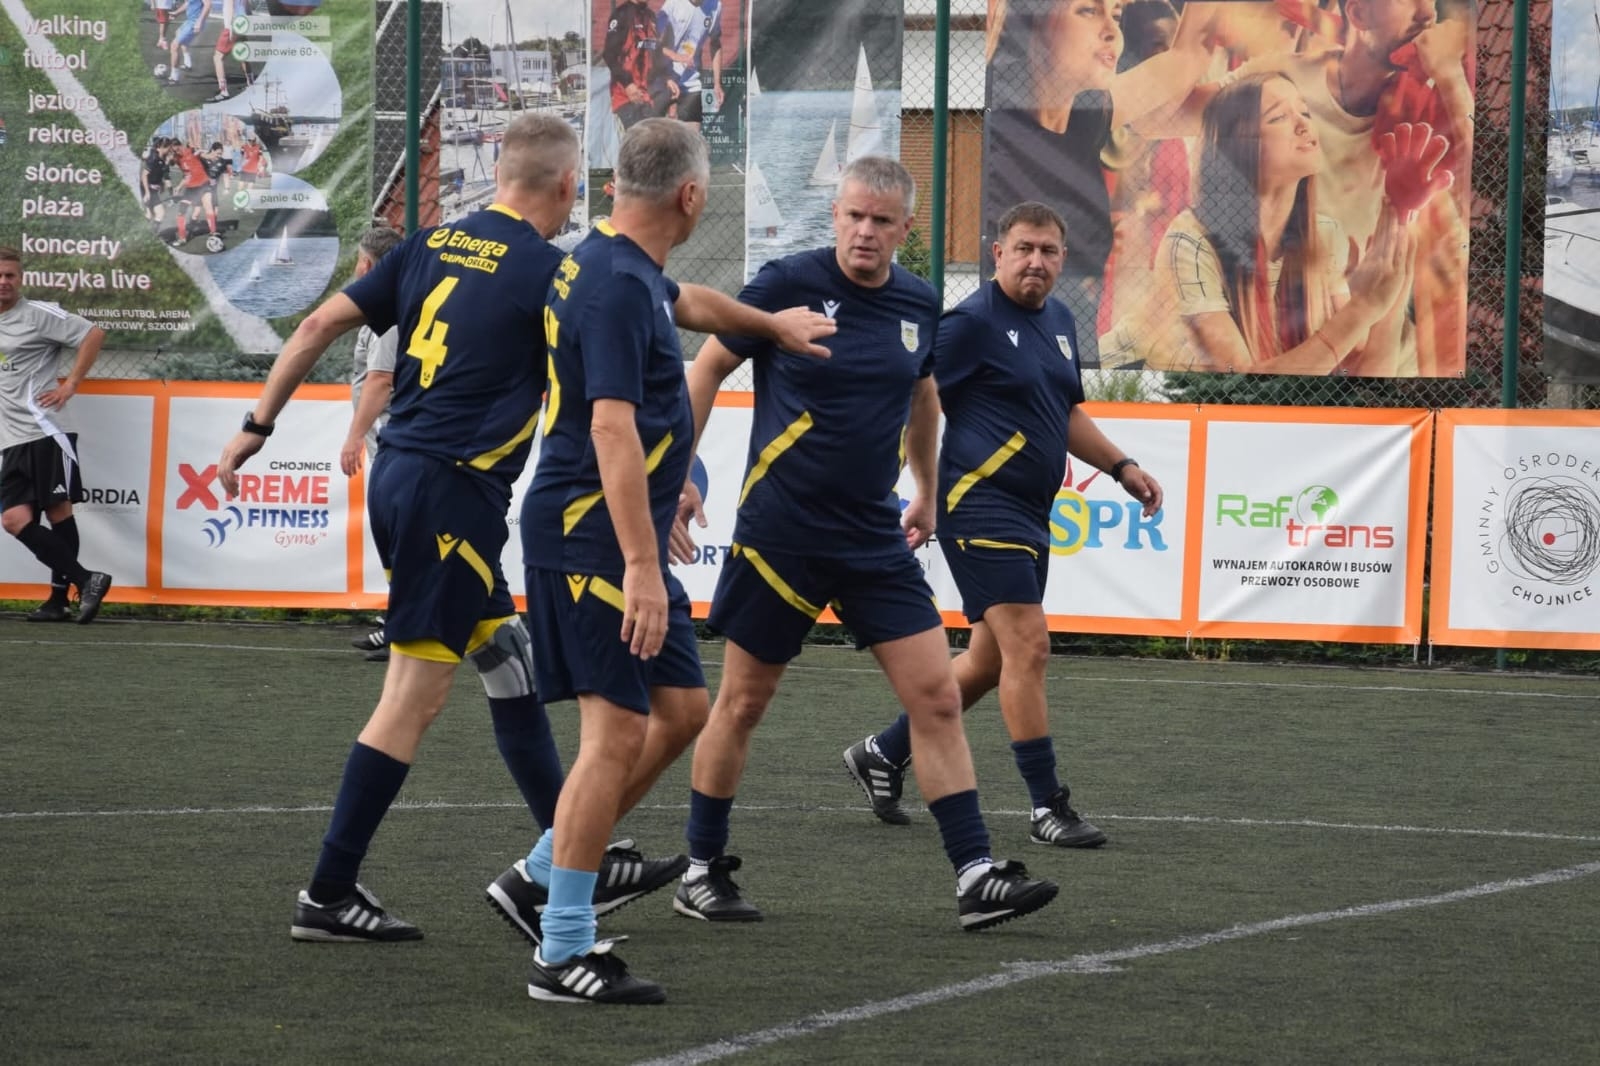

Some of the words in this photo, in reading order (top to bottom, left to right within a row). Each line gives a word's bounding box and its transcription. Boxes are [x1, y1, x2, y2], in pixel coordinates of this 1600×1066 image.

[25, 15, 106, 41] walking
[253, 21, 296, 31] panowie
[299, 21, 320, 30] 50+
[23, 48, 88, 69] futbol
[254, 47, 297, 57] panowie
[299, 47, 318, 56] 60+
[27, 89, 99, 113] jezioro
[28, 123, 128, 149] rekreacja
[24, 162, 102, 184] słońce
[22, 195, 84, 218] plaża
[260, 193, 289, 203] panie
[22, 233, 121, 260] koncerty
[446, 230, 509, 257] Energa
[466, 256, 496, 272] ORLEN
[22, 268, 106, 293] muzyka
[111, 269, 152, 289] live
[77, 308, 121, 318] WALKING
[122, 309, 157, 319] FUTBOL
[159, 310, 191, 319] ARENA
[147, 322, 189, 331] SZKOLNA
[406, 276, 460, 389] 4
[269, 461, 331, 472] CHOJNICE
[247, 508, 329, 528] FITNESS
[1216, 494, 1293, 528] Raf
[1286, 518, 1394, 548] trans
[1479, 486, 1500, 574] GMINNY
[1213, 559, 1268, 571] WYNAJEM
[1270, 560, 1342, 572] AUTOKARÓW
[1350, 561, 1393, 573] BUSÓW
[1241, 576, 1301, 587] PRZEWOZY
[1303, 577, 1360, 588] OSOBOWE
[1512, 585, 1593, 606] CHOJNICE
